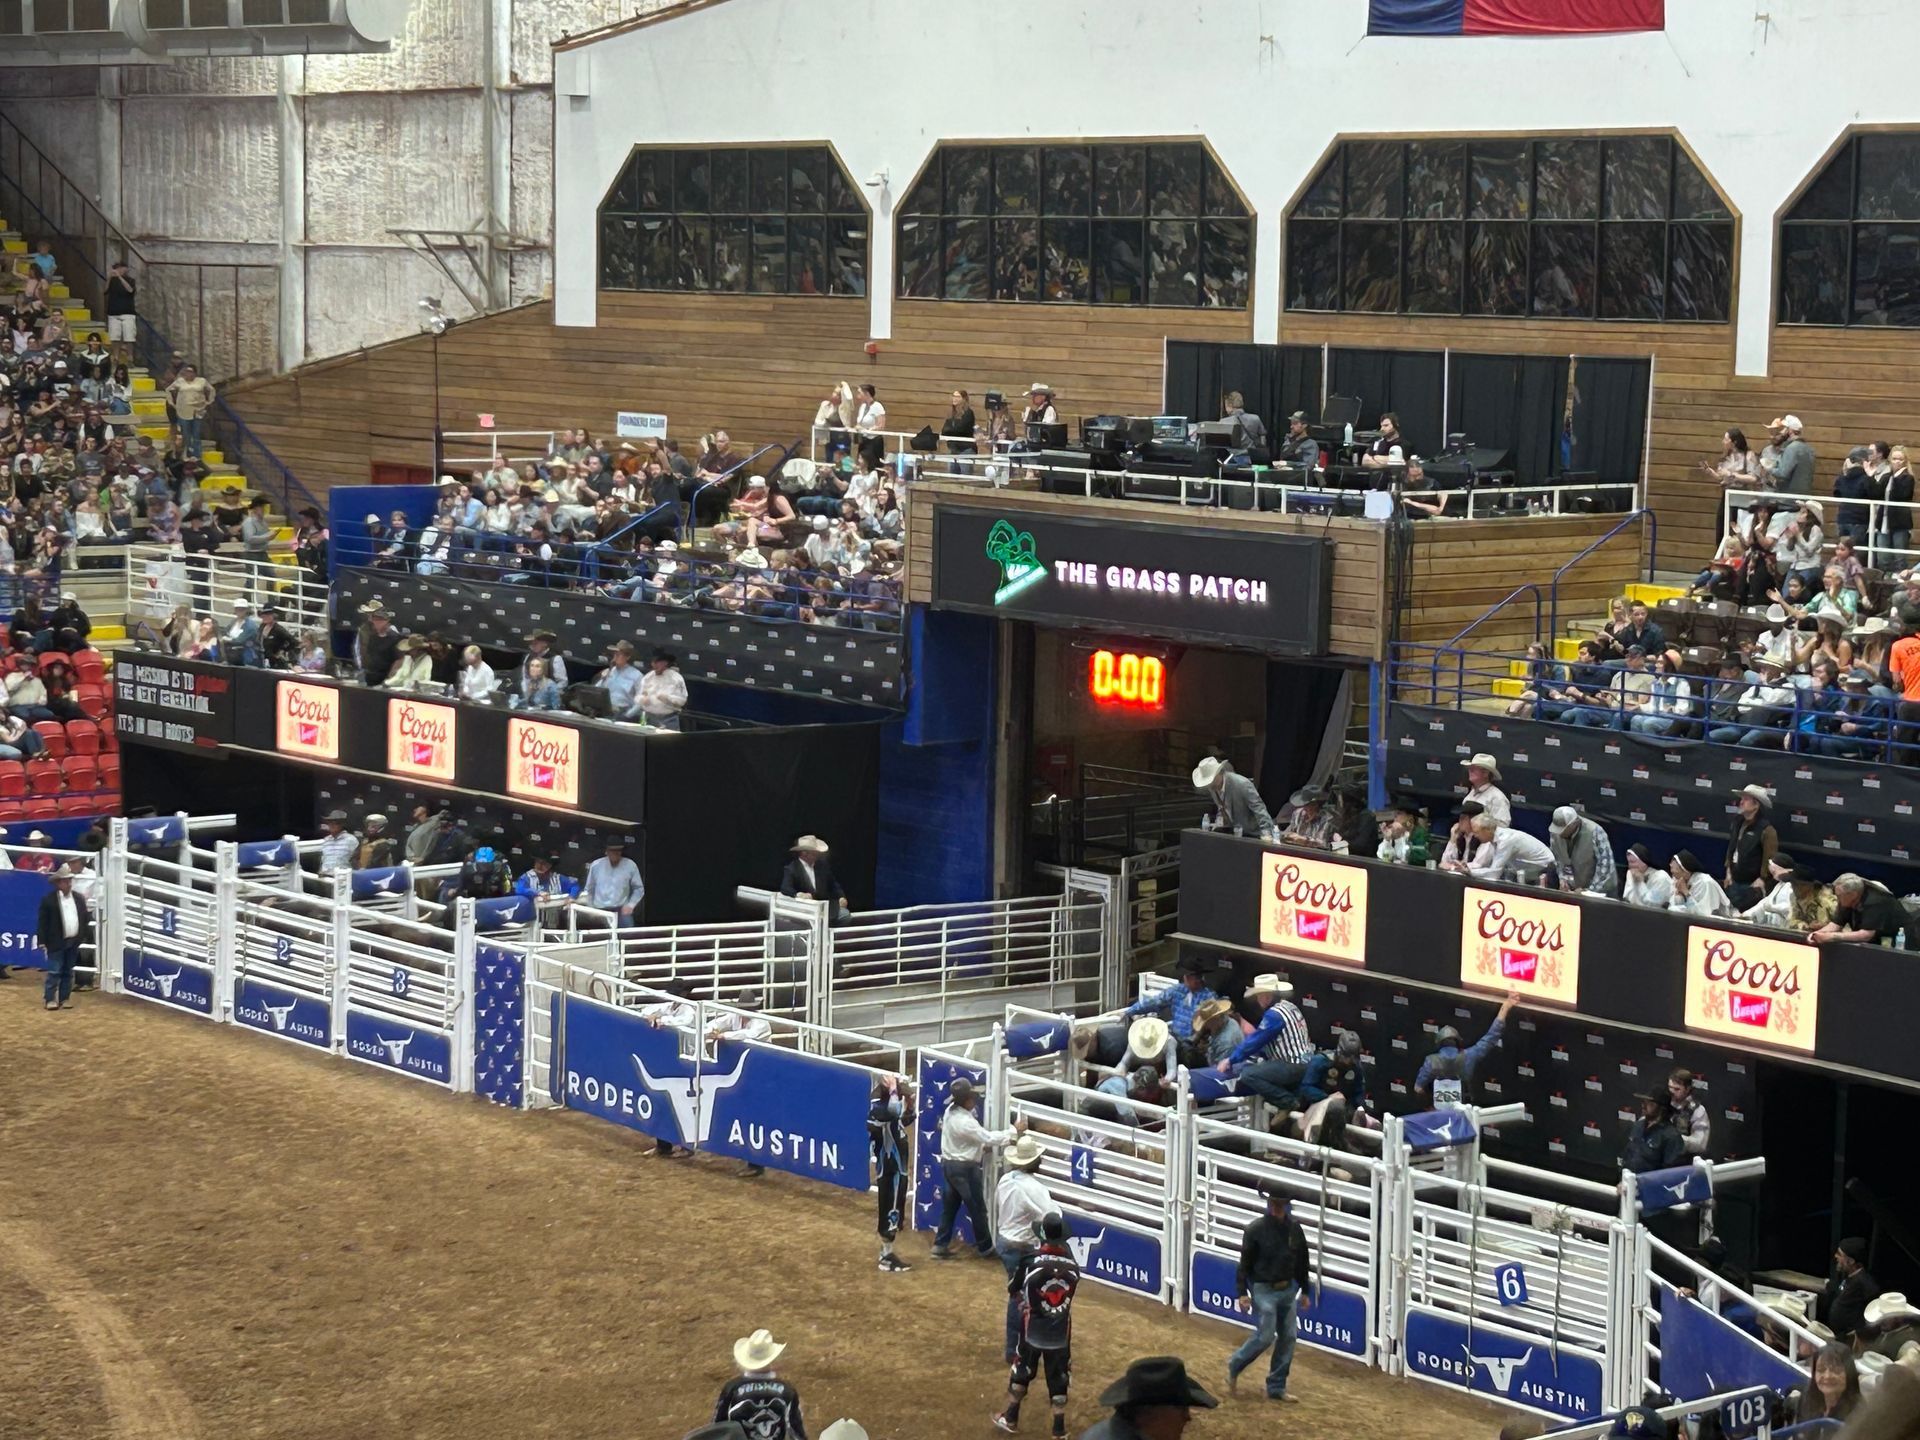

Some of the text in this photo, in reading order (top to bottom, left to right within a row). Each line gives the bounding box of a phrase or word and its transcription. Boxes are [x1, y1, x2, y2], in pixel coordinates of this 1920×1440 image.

[1054, 560, 1268, 602] THE GRASS PATCH
[286, 688, 331, 723] Coors
[399, 704, 448, 743] Coors
[519, 727, 570, 765] Coors
[1274, 863, 1354, 913] Coors
[1477, 899, 1565, 951] Coors
[279, 940, 291, 961] 2
[1703, 939, 1801, 995] Coors
[395, 970, 406, 993] 3
[567, 1070, 838, 1170] RODEO AUSTIN
[1075, 1151, 1090, 1180] 4
[1095, 1257, 1149, 1284] AUSTIN
[1502, 1267, 1521, 1300] 6
[1202, 1289, 1253, 1315] RODE
[1416, 1350, 1587, 1412] RODEO AUSTIN
[1726, 1395, 1766, 1428] 103
